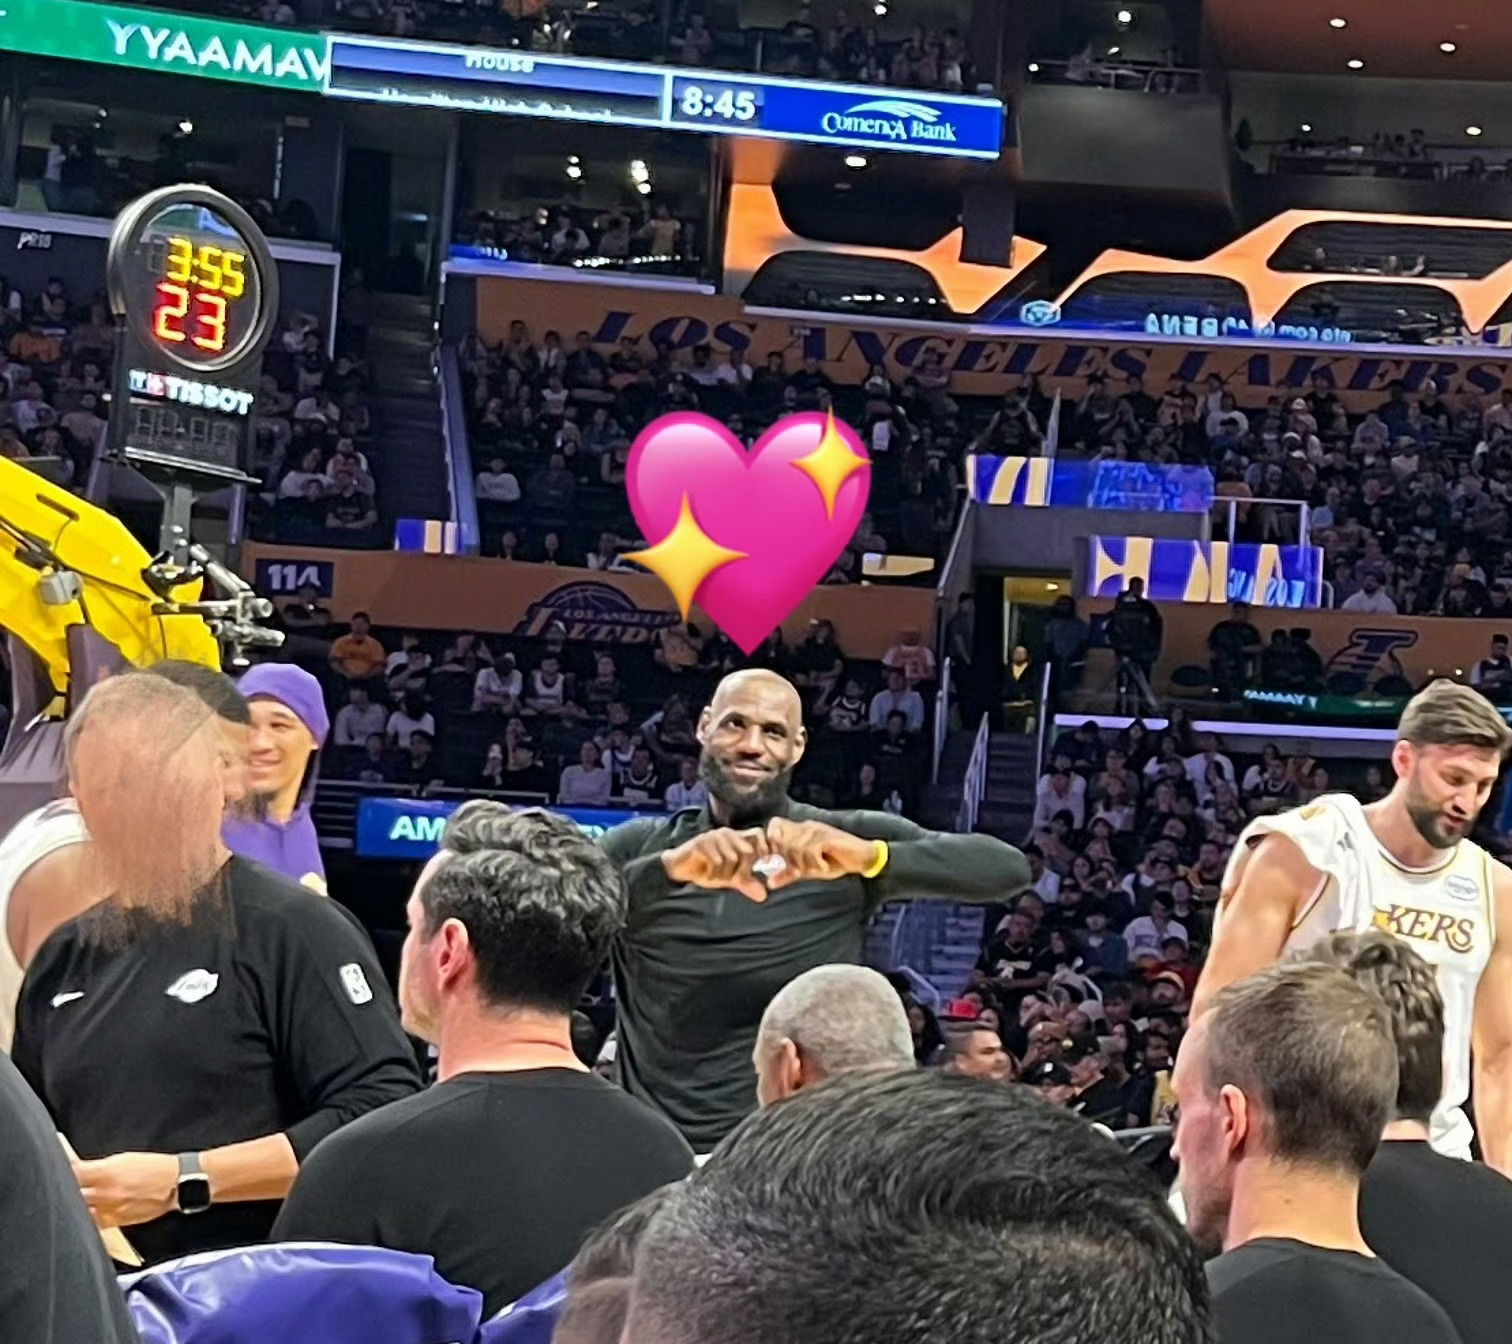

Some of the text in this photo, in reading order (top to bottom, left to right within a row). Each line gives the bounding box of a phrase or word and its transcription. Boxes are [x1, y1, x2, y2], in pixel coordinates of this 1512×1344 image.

[682, 86, 756, 121] 8:45
[910, 120, 957, 142] Bank
[167, 237, 246, 298] 3:55
[155, 281, 228, 351] 23
[165, 375, 254, 415] TISSOT
[1388, 903, 1476, 955] KERS
